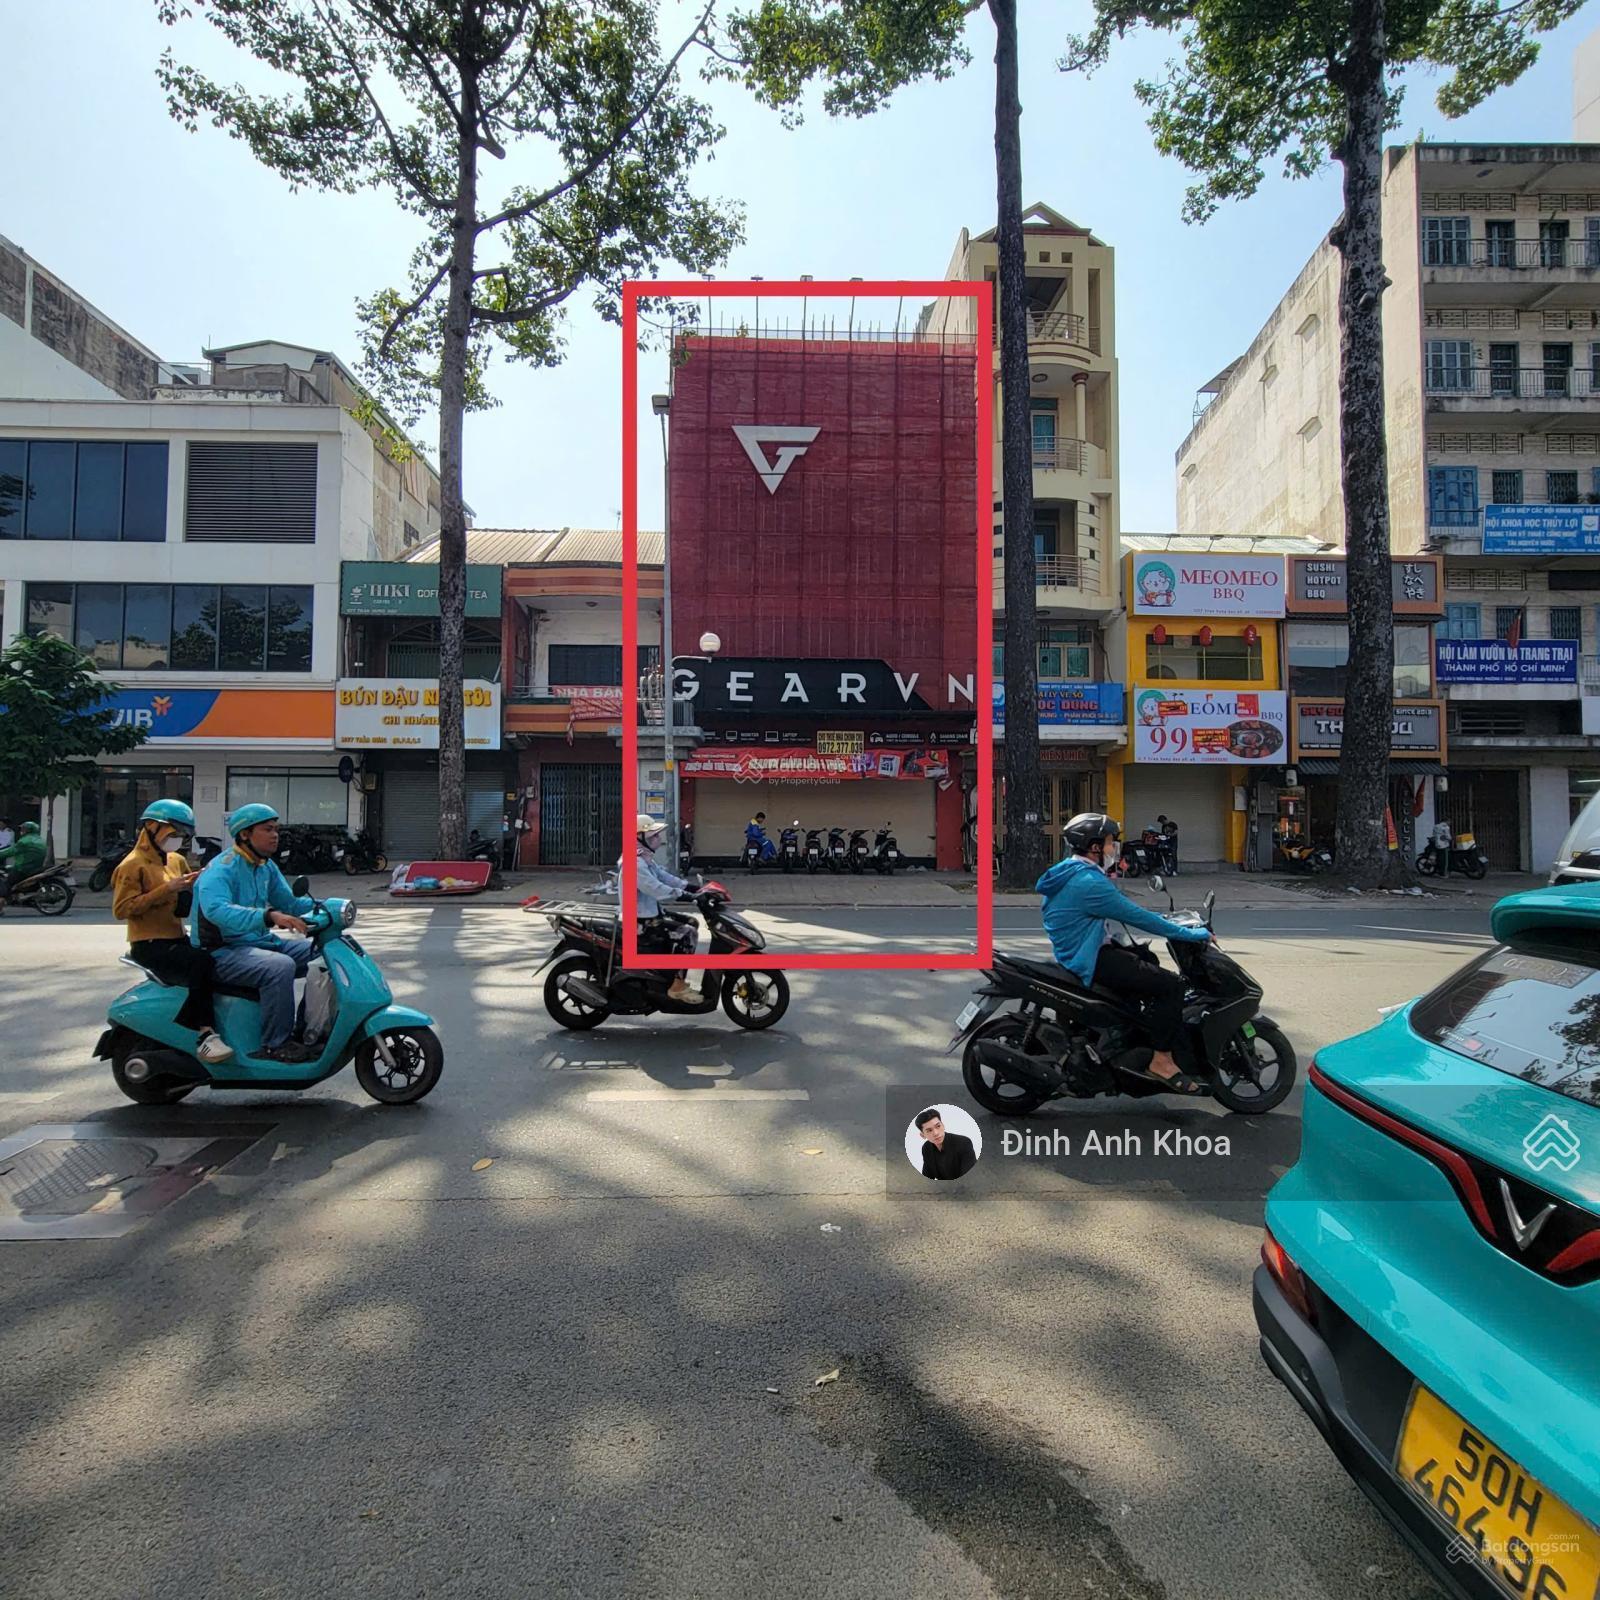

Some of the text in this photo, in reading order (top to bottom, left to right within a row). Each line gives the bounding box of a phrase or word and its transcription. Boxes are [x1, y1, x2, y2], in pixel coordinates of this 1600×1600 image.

[1501, 518, 1522, 528] KHOA
[1307, 563, 1335, 572] SUSHI
[1180, 569, 1278, 587] MEOMEO
[1307, 576, 1341, 585] HOTPOT
[469, 590, 488, 599] TEA
[1213, 587, 1245, 601] BBQ
[1307, 589, 1326, 599] BBQ
[1440, 644, 1455, 663] HỘI
[1457, 644, 1478, 660] LÀM
[1480, 643, 1505, 660] VƯỜN
[1520, 647, 1550, 660] TRANG
[1552, 647, 1573, 663] TRẠI
[1445, 662, 1476, 672] THÀNH
[1480, 661, 1500, 672] PHỐ
[1520, 662, 1538, 672] CHÍ
[1540, 664, 1566, 673] MINH
[671, 668, 974, 704] GEARVN
[340, 686, 378, 706] BÚN
[382, 687, 419, 709] ĐẬU
[464, 687, 492, 706] TÔI
[383, 716, 401, 726] CHI
[1261, 711, 1283, 721] BBQ
[1456, 1428, 1545, 1537] 50H
